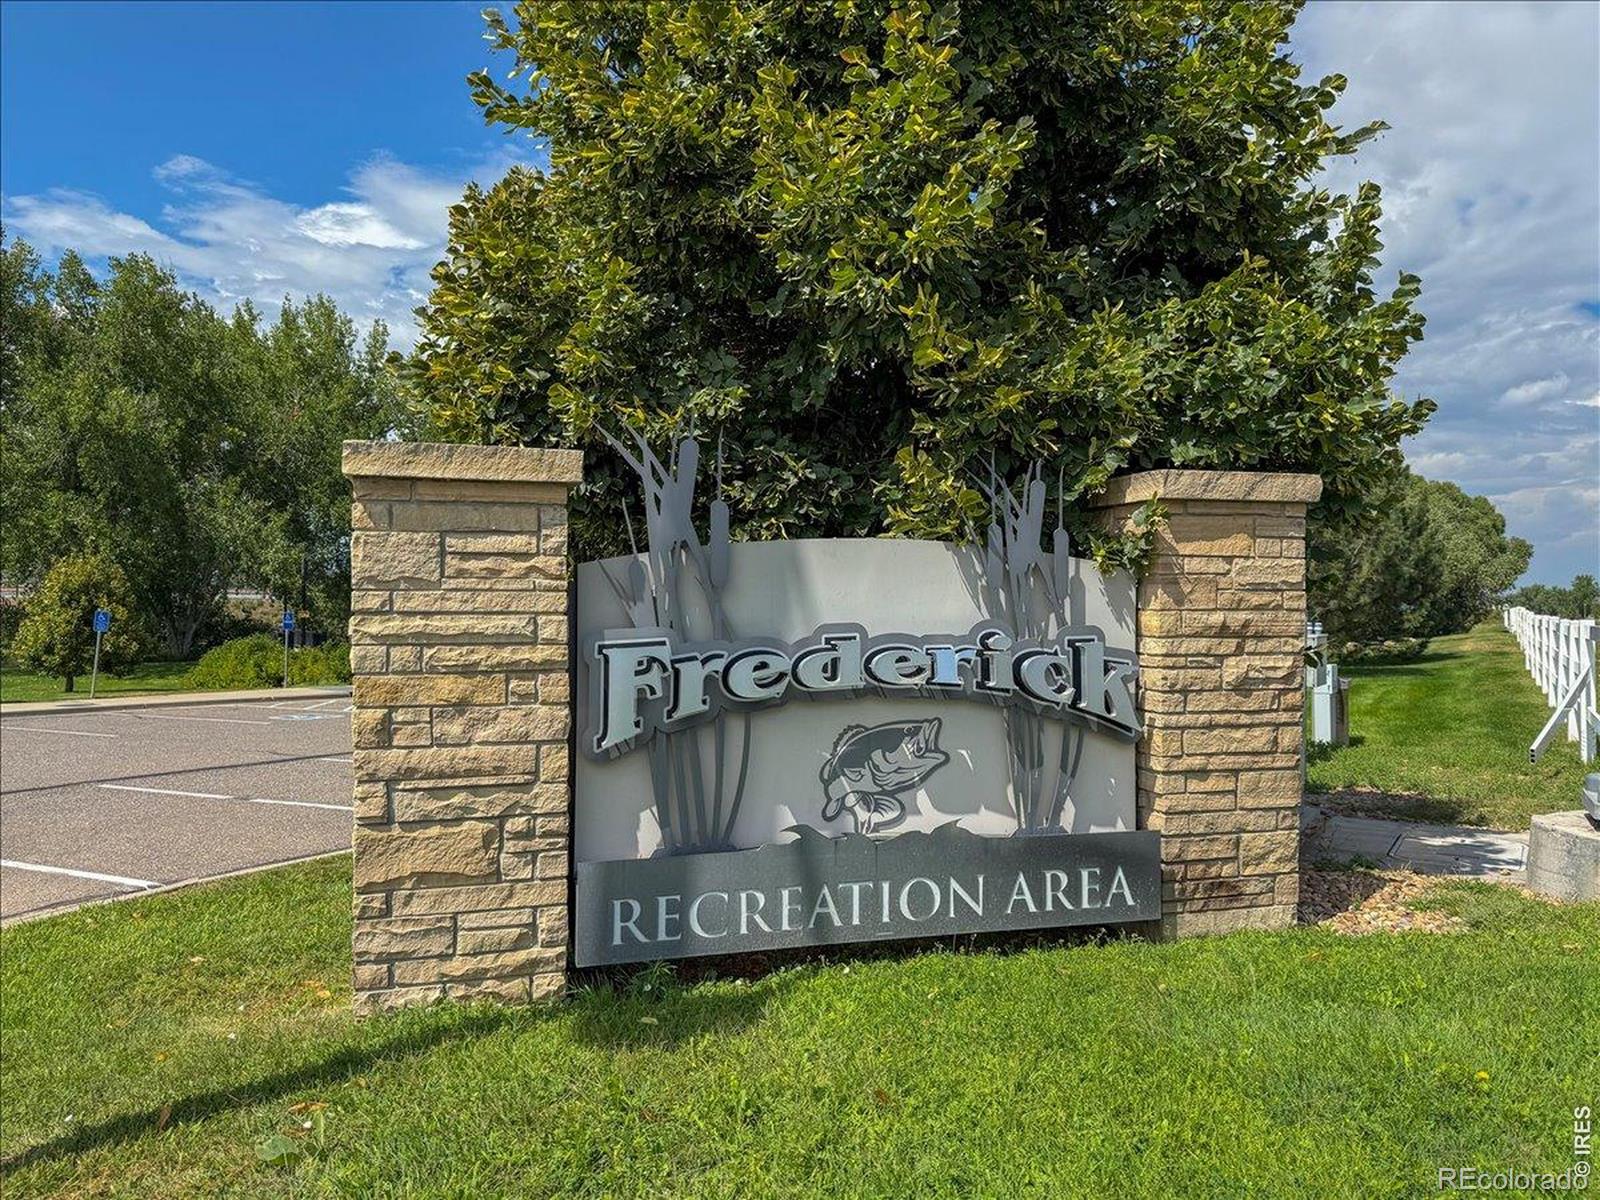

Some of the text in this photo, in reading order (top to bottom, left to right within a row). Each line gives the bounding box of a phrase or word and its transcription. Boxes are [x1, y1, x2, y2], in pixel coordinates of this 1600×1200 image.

[593, 629, 1142, 753] Frederick
[611, 865, 1138, 947] RECREATION AREA
